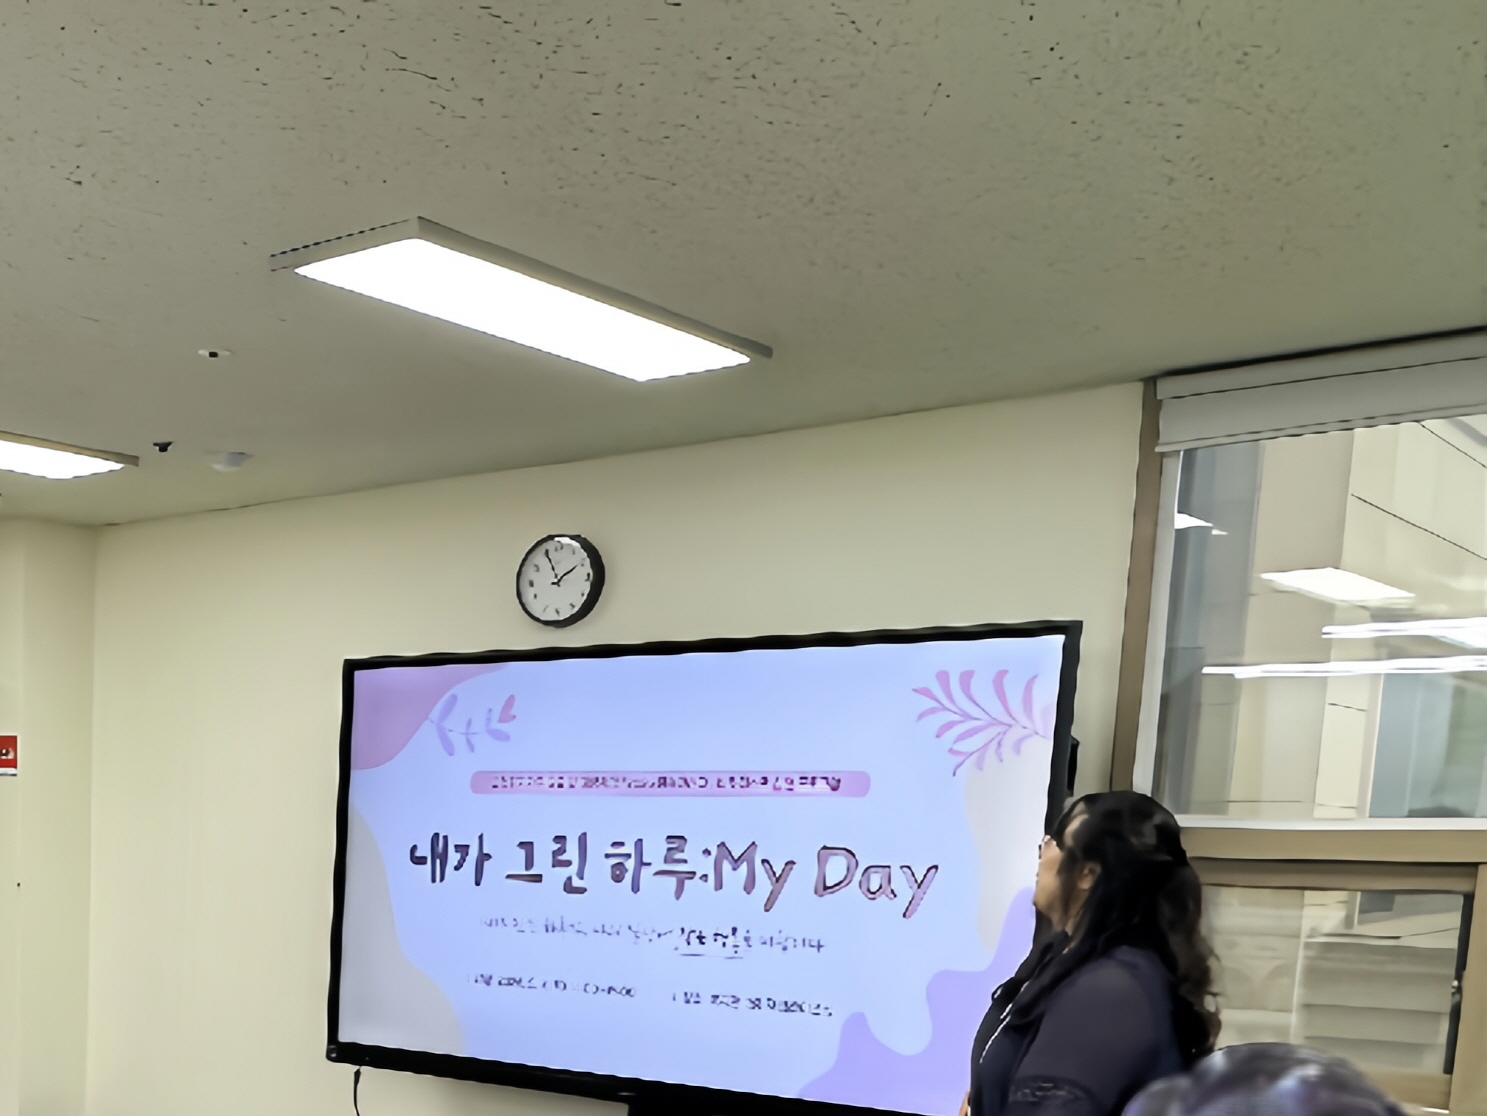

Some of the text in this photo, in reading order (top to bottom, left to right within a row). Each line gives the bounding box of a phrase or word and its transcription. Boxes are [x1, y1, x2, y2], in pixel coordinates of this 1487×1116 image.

[409, 831, 940, 918] 내가 그린 하루:My Day
